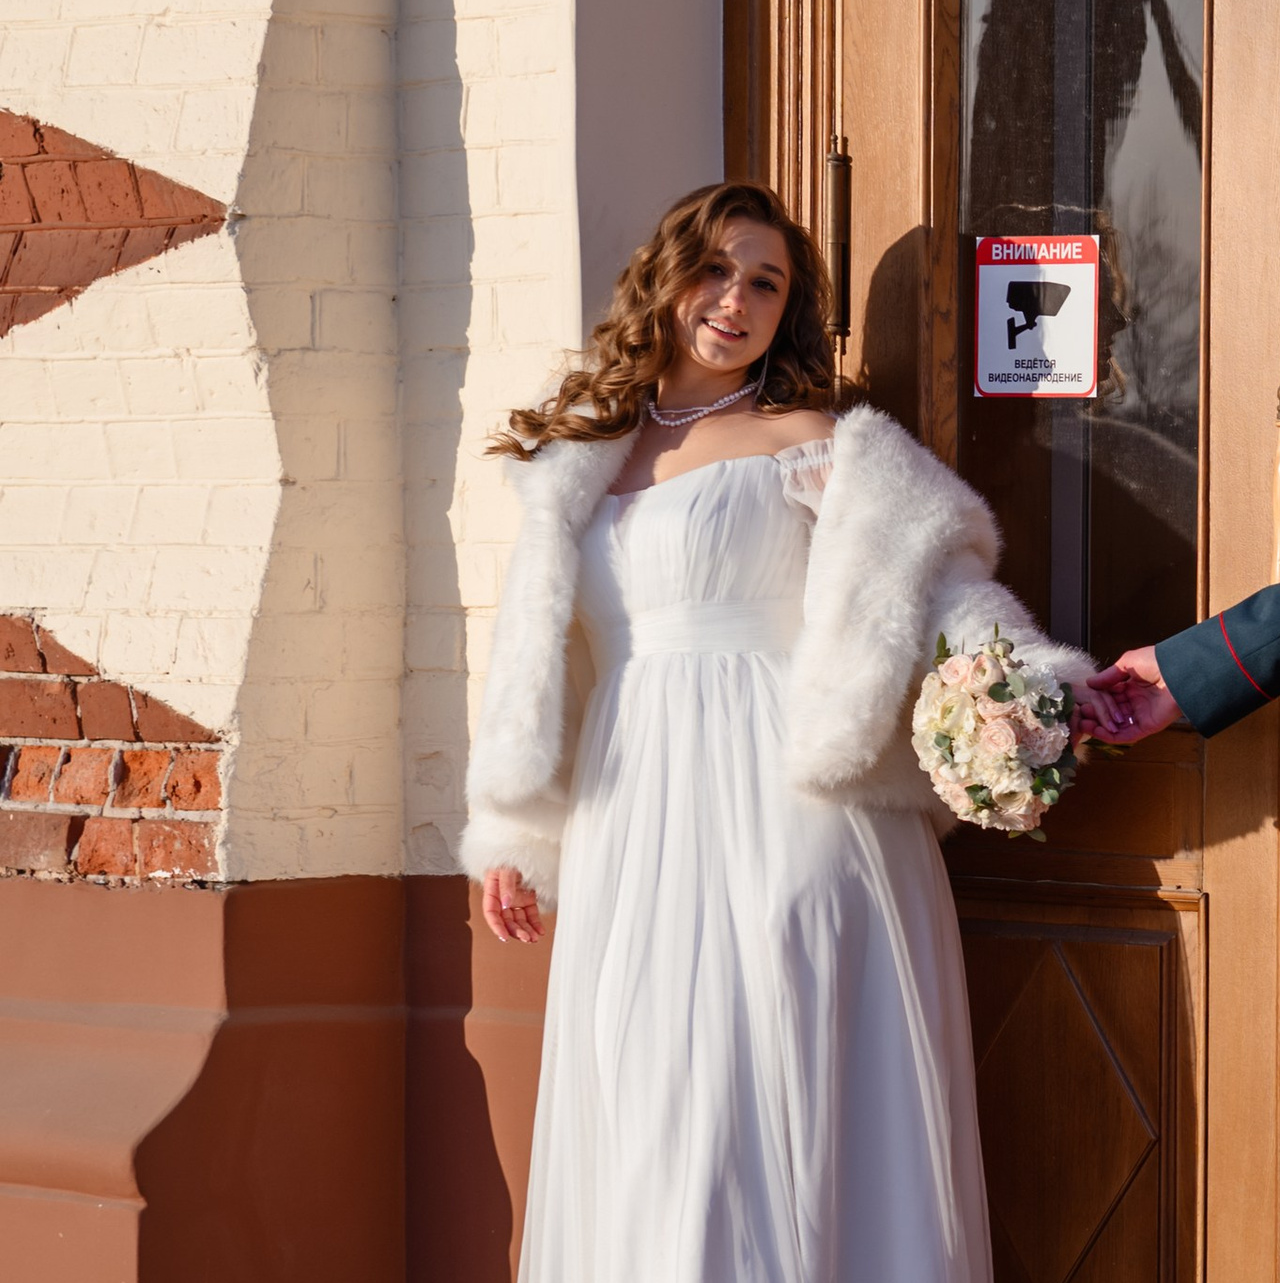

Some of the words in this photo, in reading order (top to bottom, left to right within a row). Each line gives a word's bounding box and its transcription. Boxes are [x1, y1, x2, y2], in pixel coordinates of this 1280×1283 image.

[991, 242, 1083, 261] ВНИМАНИЕ
[1014, 358, 1056, 370] ВЕДЁТСЯ
[988, 373, 1082, 384] ВИДЕОНАБЛЮДЕНИЕ
